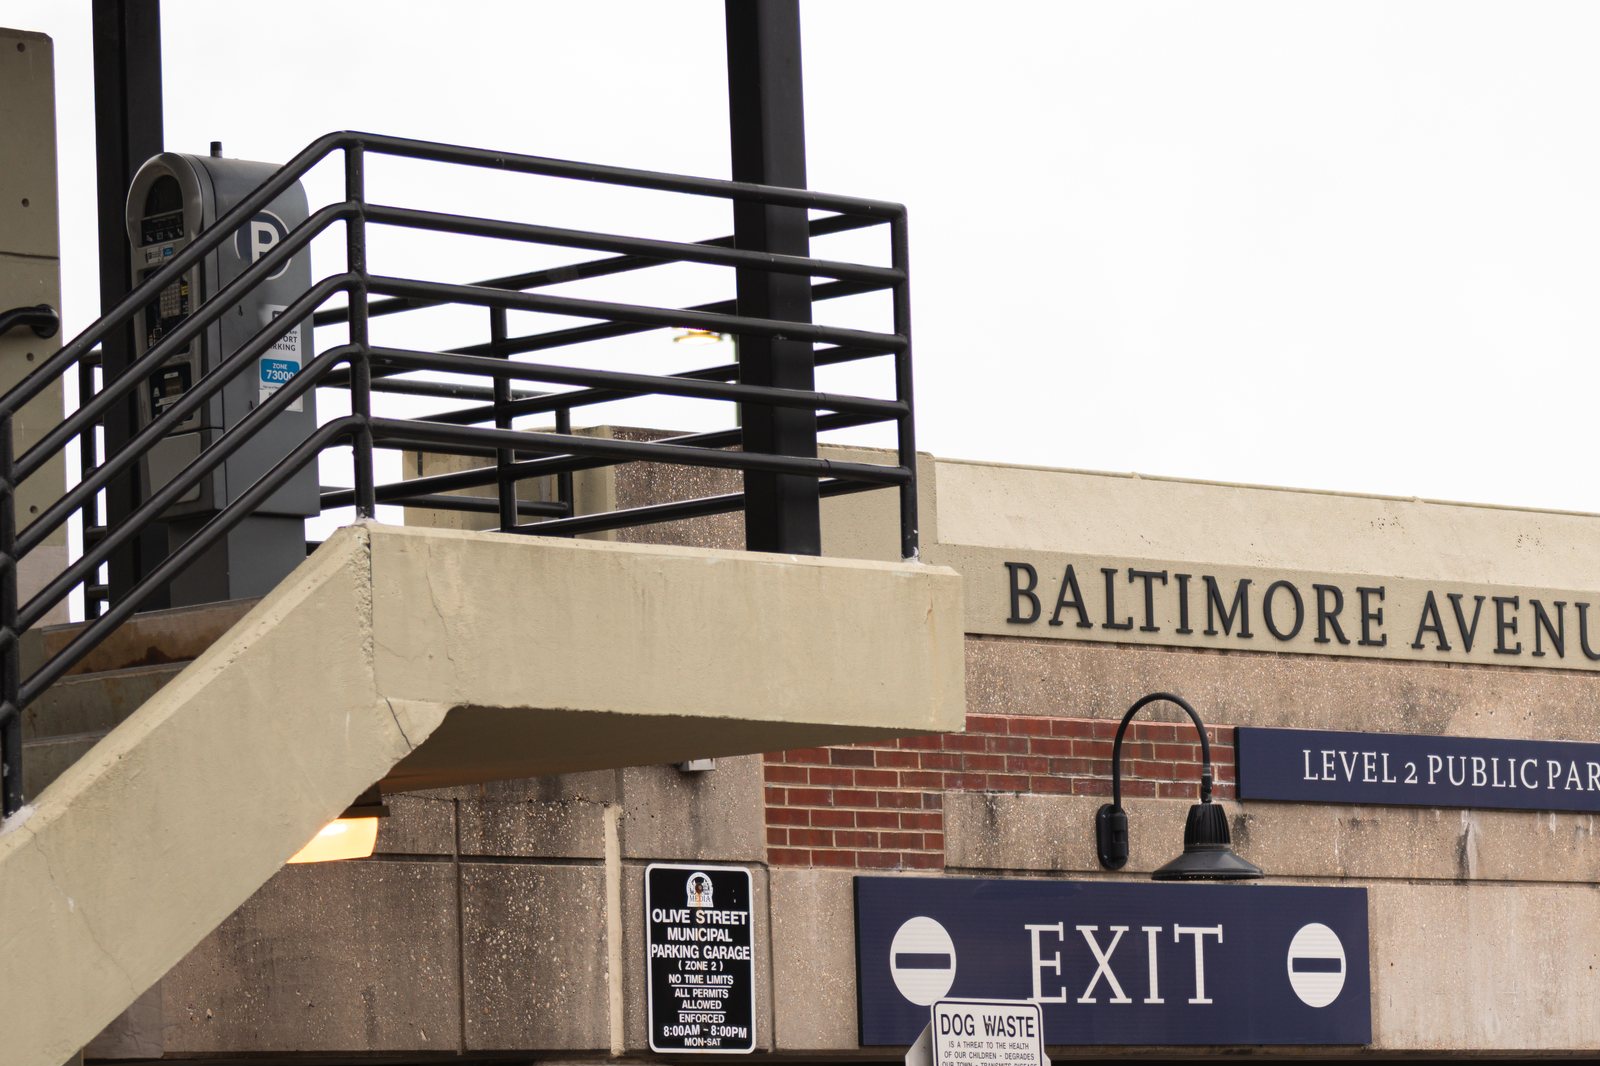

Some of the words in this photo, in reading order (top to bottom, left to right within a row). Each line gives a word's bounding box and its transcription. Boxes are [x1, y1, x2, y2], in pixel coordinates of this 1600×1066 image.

[251, 220, 280, 265] P
[1005, 561, 1387, 646] BALTIMORE
[1302, 749, 1396, 784] LEVEL
[1405, 764, 1418, 784] 2
[1428, 755, 1540, 790] PUBLIC
[652, 909, 690, 923] OLIVE
[696, 910, 747, 925] STREET
[667, 927, 732, 942] MUNICIPAL
[652, 944, 699, 959] PARKING
[704, 946, 750, 960] GARAGE
[685, 961, 708, 970] ZONE
[711, 962, 716, 970] 2
[1025, 923, 1224, 1006] EXIT
[669, 974, 681, 983] NO
[684, 975, 703, 984] TIME
[707, 975, 733, 984] LIMITS
[675, 988, 690, 997] ALL
[693, 989, 728, 998] PERMITS
[682, 1000, 721, 1010] ALLOWED
[679, 1014, 724, 1023] ENFORCED
[941, 1014, 975, 1036] DOG
[983, 1015, 1034, 1037] WASTE
[664, 1025, 700, 1036] 8:00AM
[711, 1026, 746, 1038] 8:00PM
[684, 1038, 721, 1047] MON-SAT
